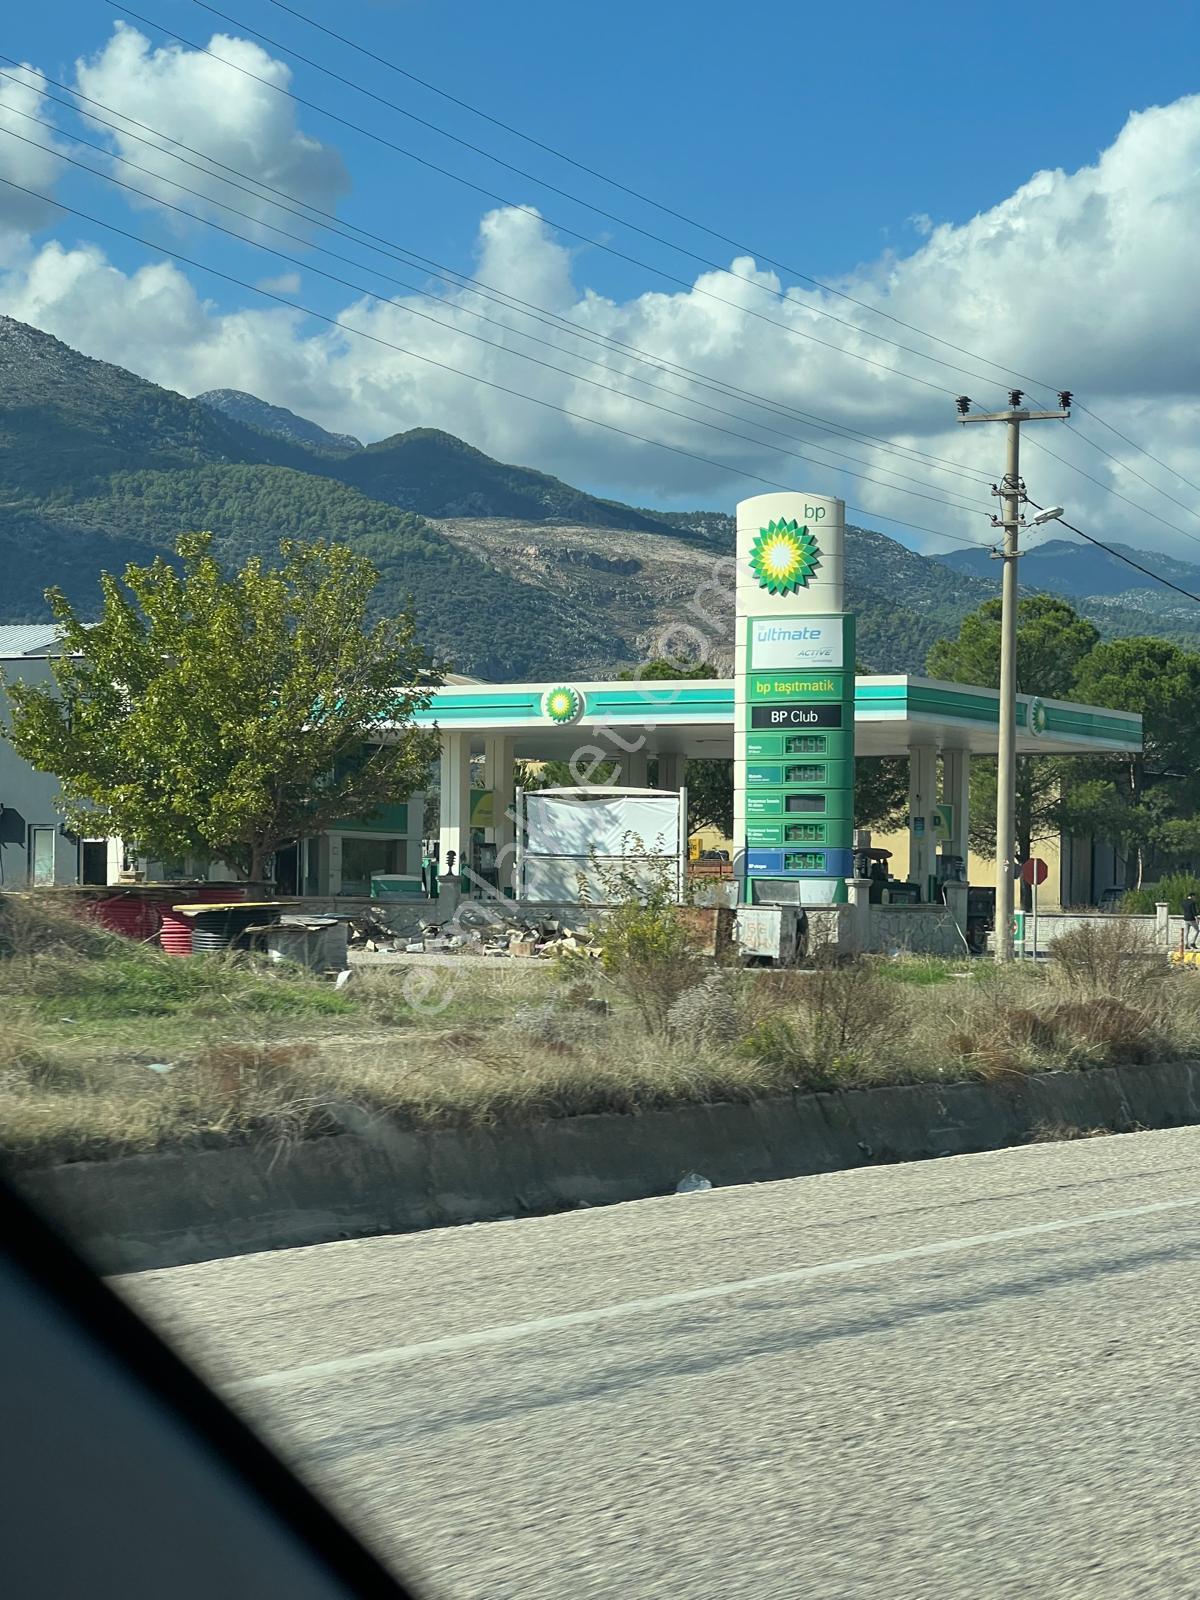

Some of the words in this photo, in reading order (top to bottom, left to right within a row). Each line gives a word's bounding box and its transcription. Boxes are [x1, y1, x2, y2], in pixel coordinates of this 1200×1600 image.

[804, 503, 826, 521] bp
[757, 626, 822, 642] ultimate
[797, 648, 833, 657] ACTIVE
[756, 681, 771, 695] bp
[774, 679, 834, 695] taşıtmatik
[771, 711, 788, 723] BP
[790, 710, 819, 723] Club
